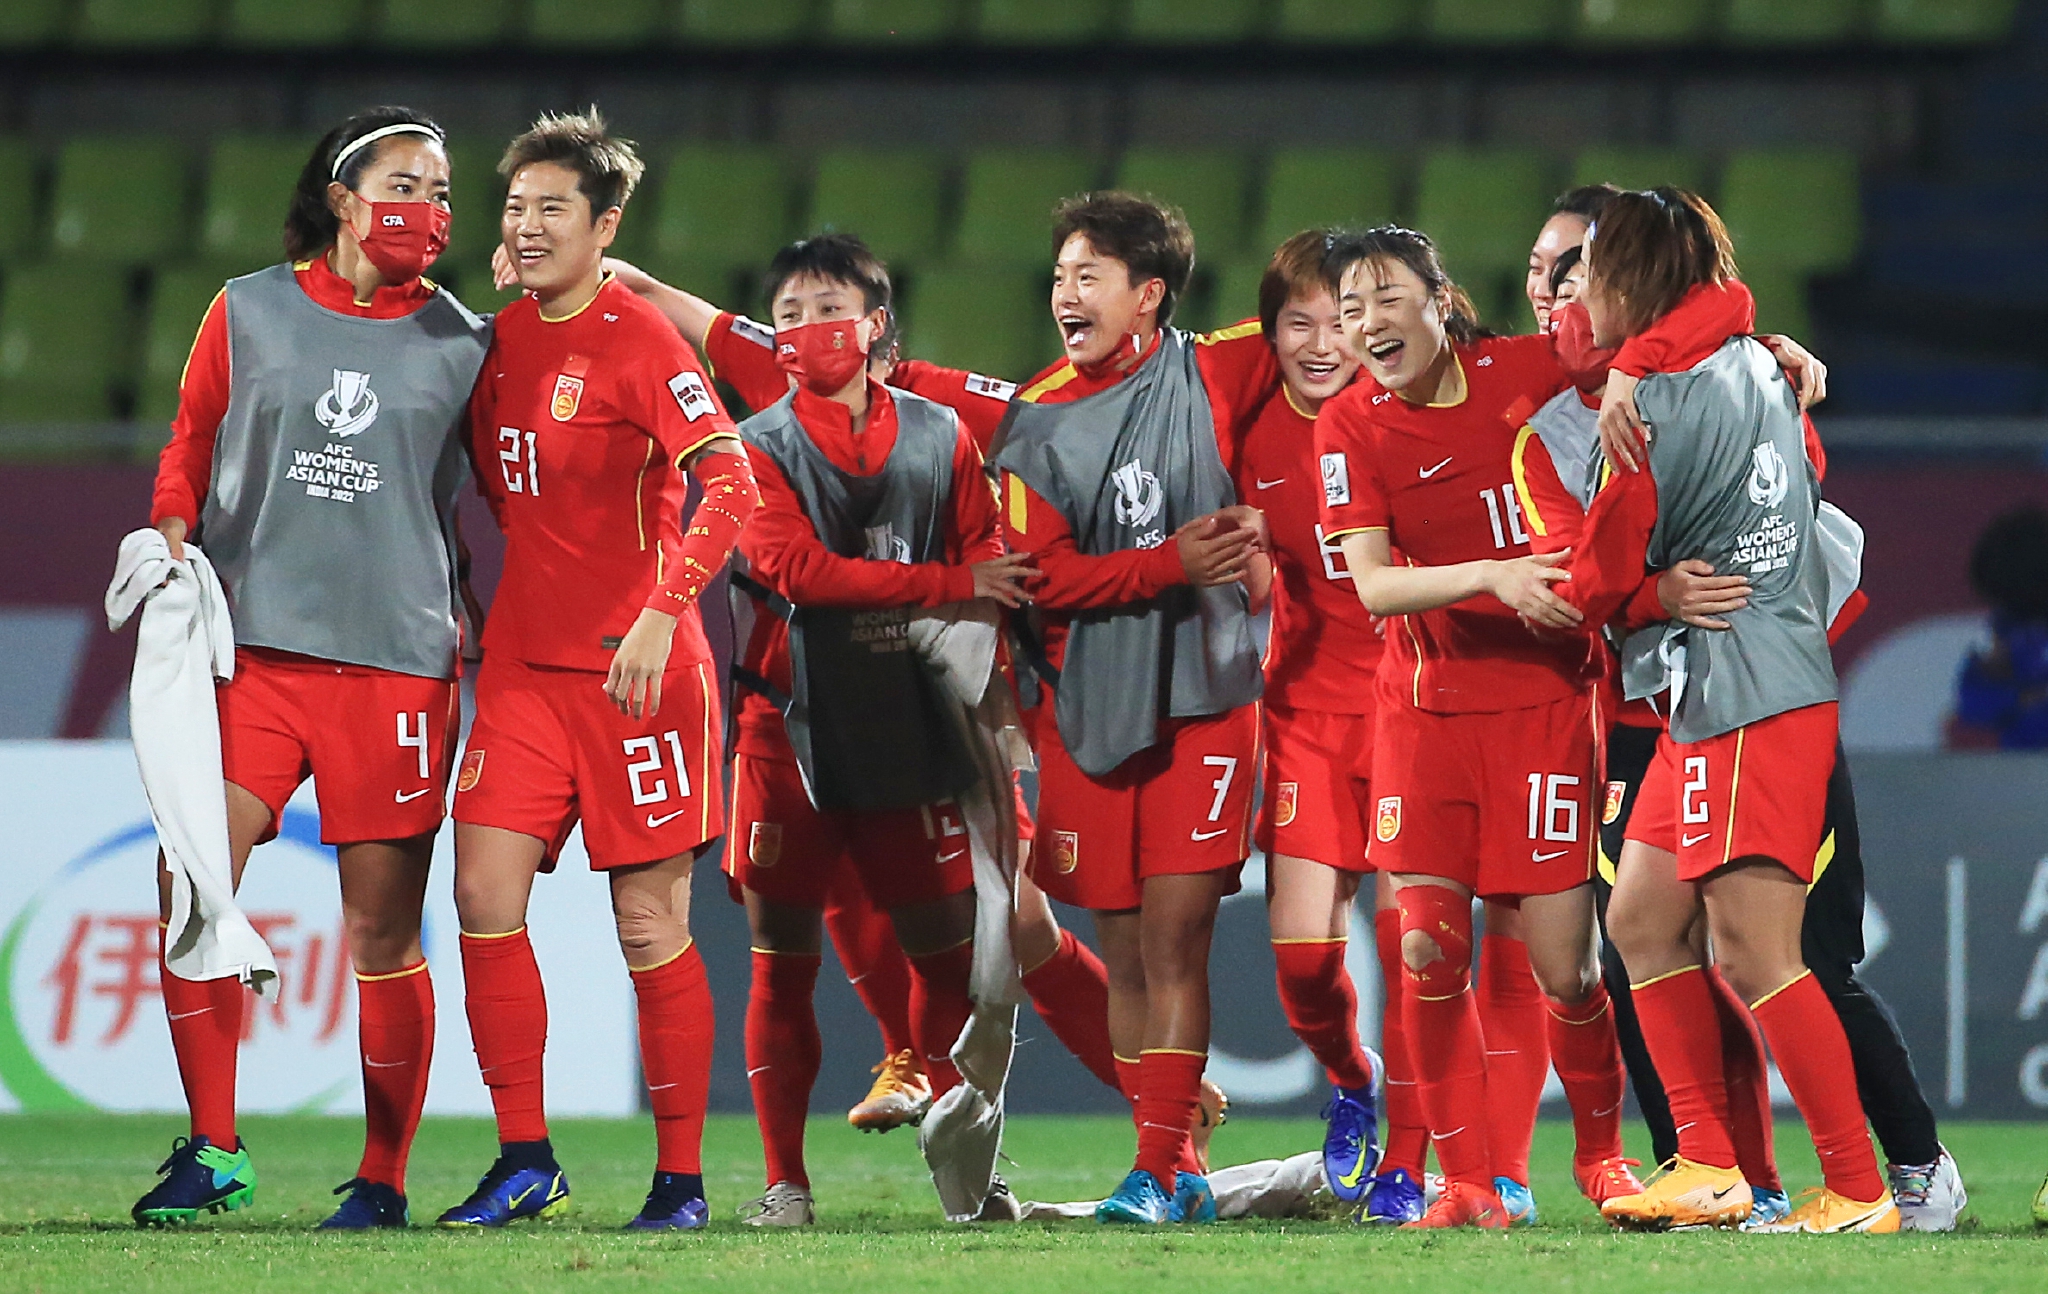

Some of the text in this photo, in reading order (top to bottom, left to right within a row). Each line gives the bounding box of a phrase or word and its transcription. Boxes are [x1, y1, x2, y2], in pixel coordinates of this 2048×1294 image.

[382, 215, 405, 227] CFA
[294, 450, 378, 478] WOMEN'S
[323, 442, 353, 458] AFC
[499, 426, 540, 497] 21
[285, 465, 379, 493] ASIAN CUP
[331, 489, 355, 503] 2022
[1736, 521, 1796, 548] WOMEN'S
[1761, 515, 1783, 530] AFC
[1135, 529, 1159, 549] AFC
[1729, 536, 1798, 564] ASIAN CUP
[396, 711, 430, 778] 4
[622, 730, 691, 806] 21
[1203, 756, 1238, 822] 7
[1682, 756, 1709, 824] 2
[1527, 773, 1580, 842] 16
